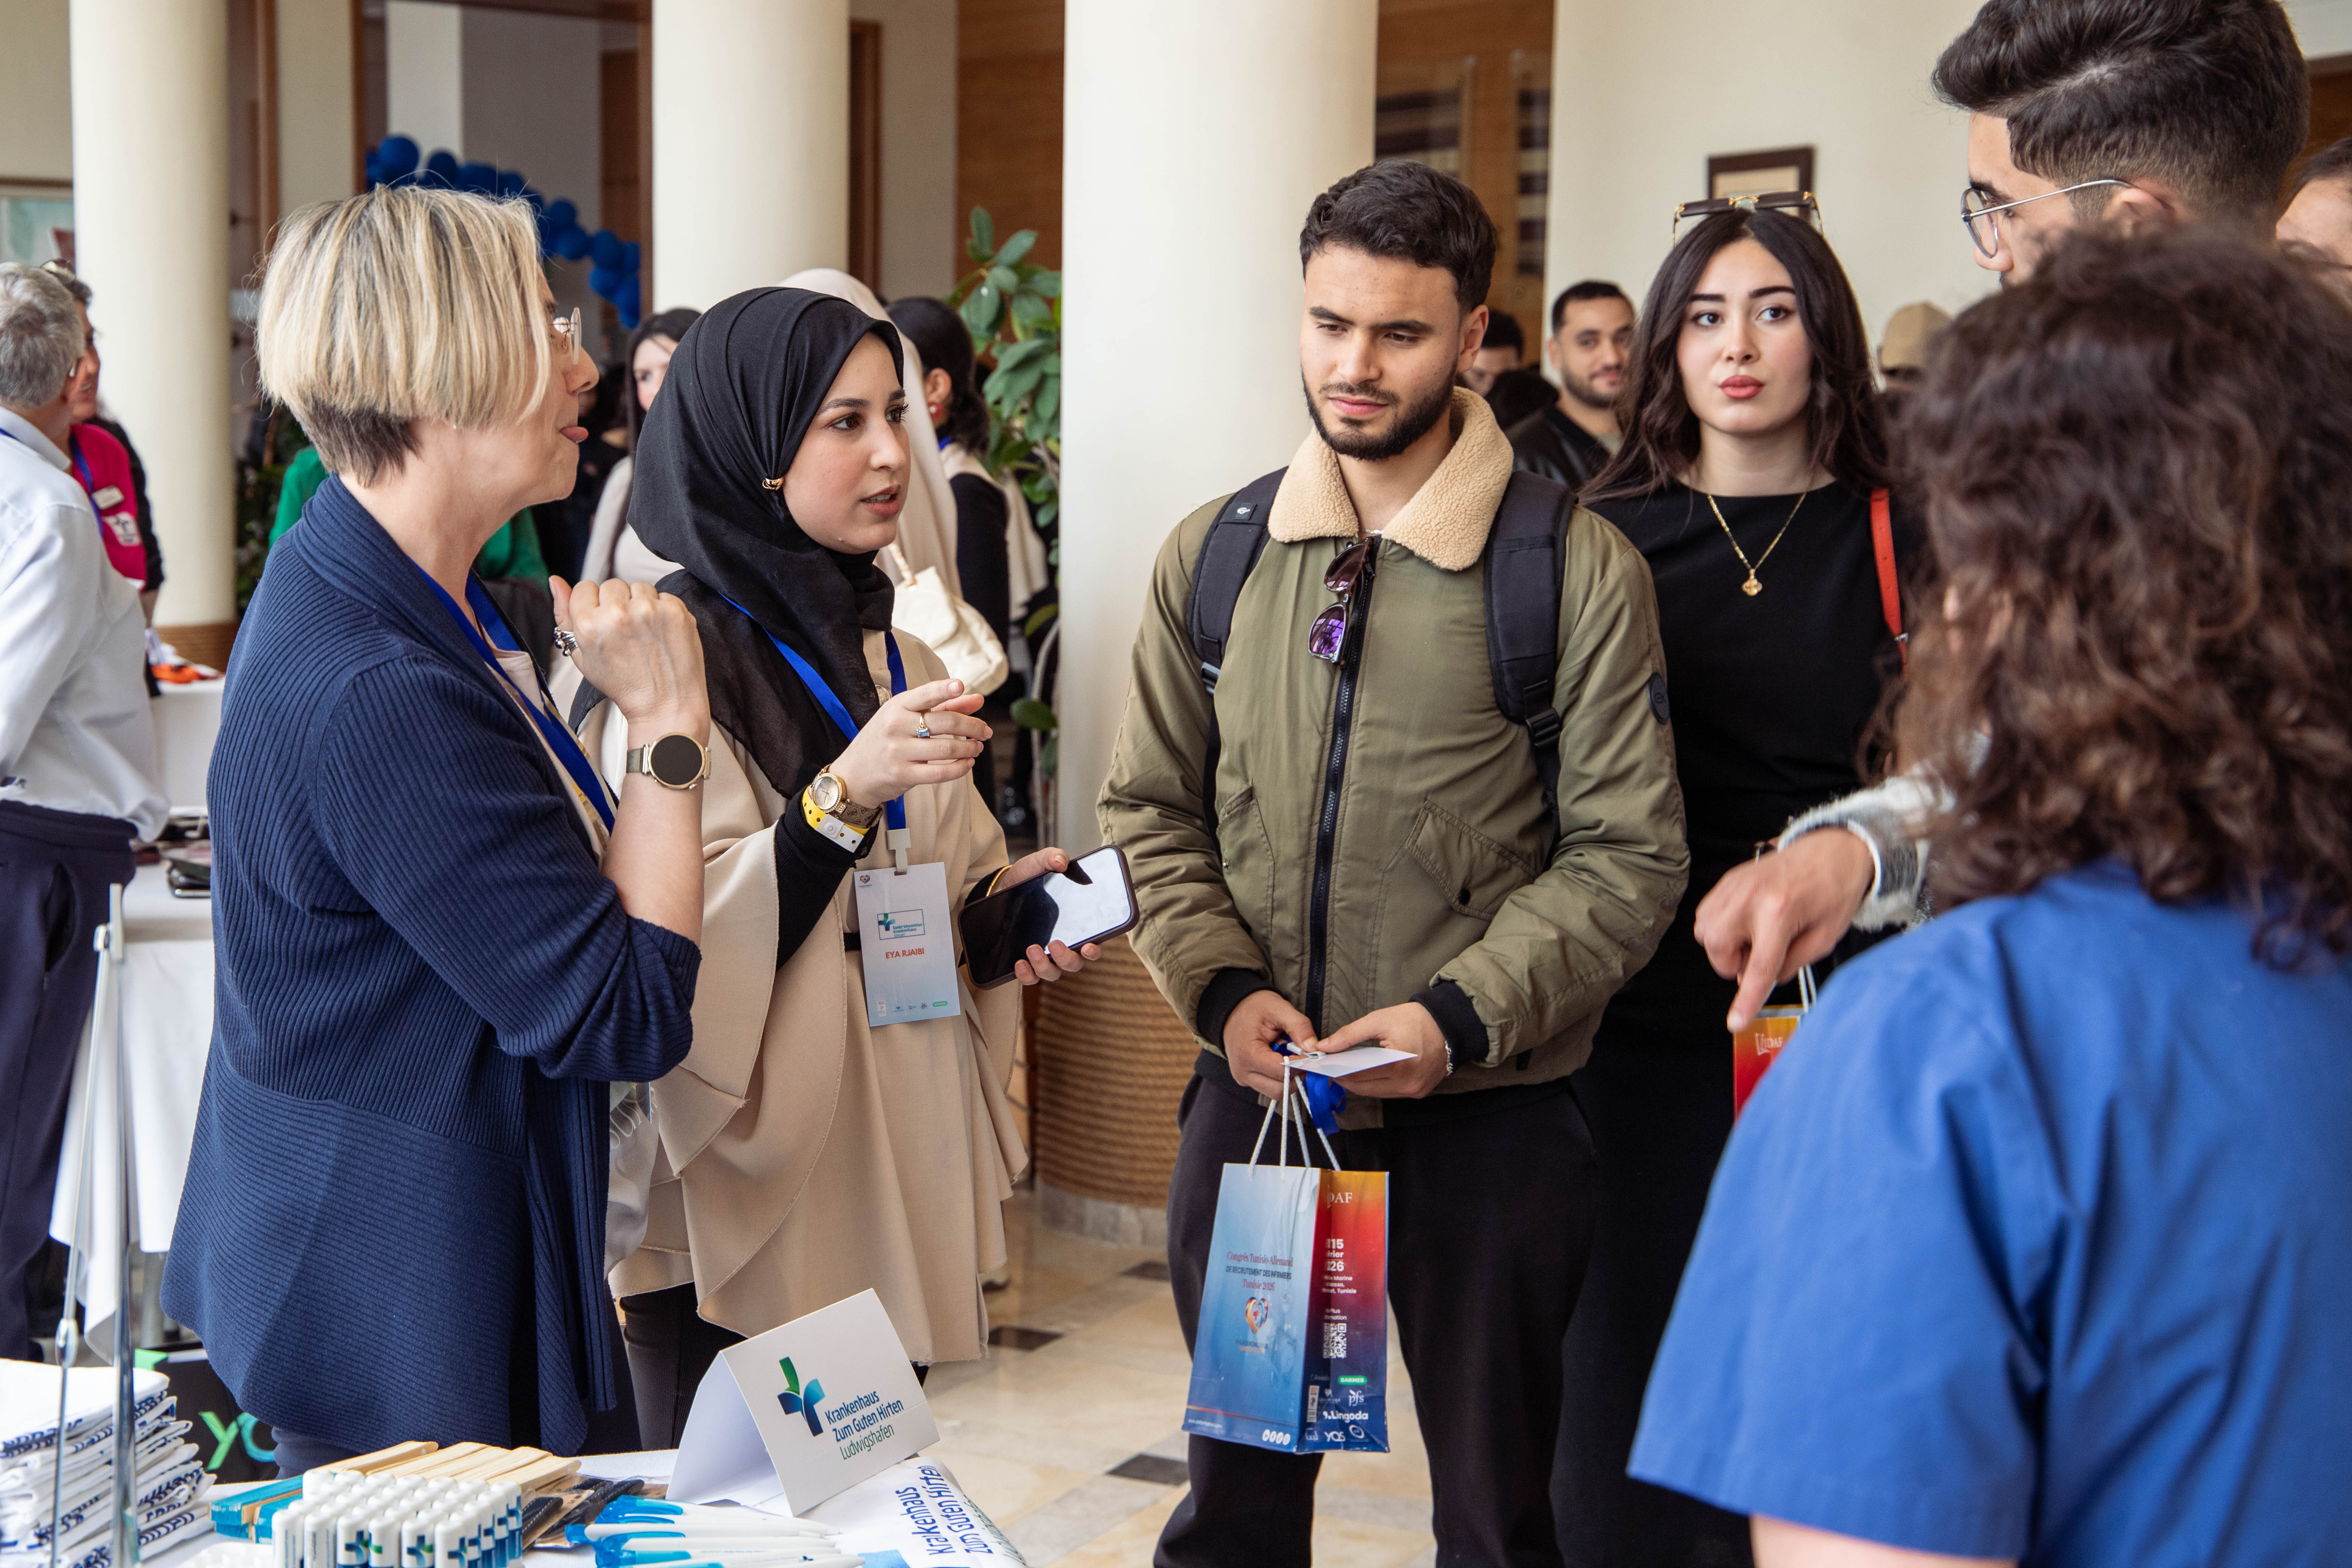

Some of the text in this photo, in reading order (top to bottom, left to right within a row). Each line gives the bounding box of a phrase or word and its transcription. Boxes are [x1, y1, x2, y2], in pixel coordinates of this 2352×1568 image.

[902, 947, 925, 957] RJAIBI
[1227, 1251, 1249, 1263] Congrès
[1226, 1265, 1292, 1280] DE RECRUTEMENT DES INFIRMIERS
[1242, 1278, 1262, 1289] Tunisie
[1348, 1389, 1364, 1406] pfs
[825, 1390, 880, 1425] Krankenhaus
[832, 1400, 904, 1442] Zum Guten Hirten
[1330, 1410, 1369, 1423] Lingoda
[839, 1424, 895, 1460] Ludwigshafen
[937, 1500, 975, 1533] Guten
[959, 1533, 994, 1554] Zum
